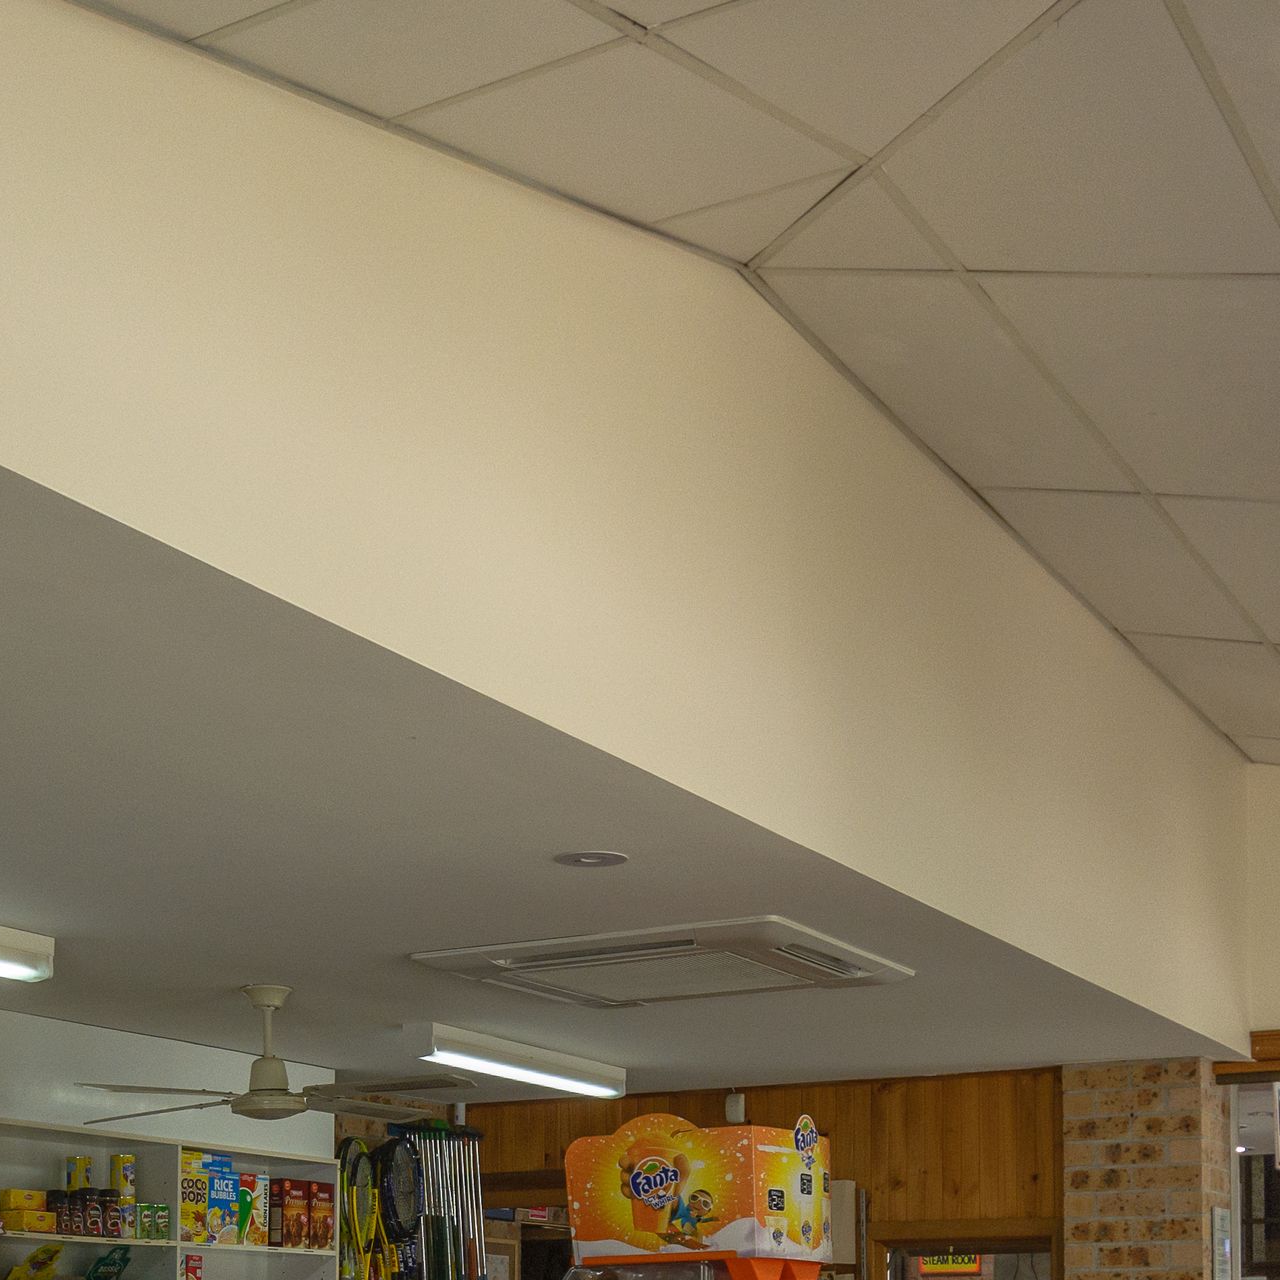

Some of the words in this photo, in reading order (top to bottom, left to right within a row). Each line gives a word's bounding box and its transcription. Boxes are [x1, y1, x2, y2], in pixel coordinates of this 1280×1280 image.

[794, 1126, 819, 1151] Fanta
[181, 1177, 207, 1190] COCO
[214, 1179, 233, 1192] RICE
[630, 1165, 680, 1198] Fanta
[181, 1190, 207, 1205] POPS
[211, 1190, 236, 1200] BUBBLES
[652, 1196, 677, 1210] WHIRL
[922, 1255, 949, 1265] STEAM
[951, 1254, 977, 1265] ROOM
